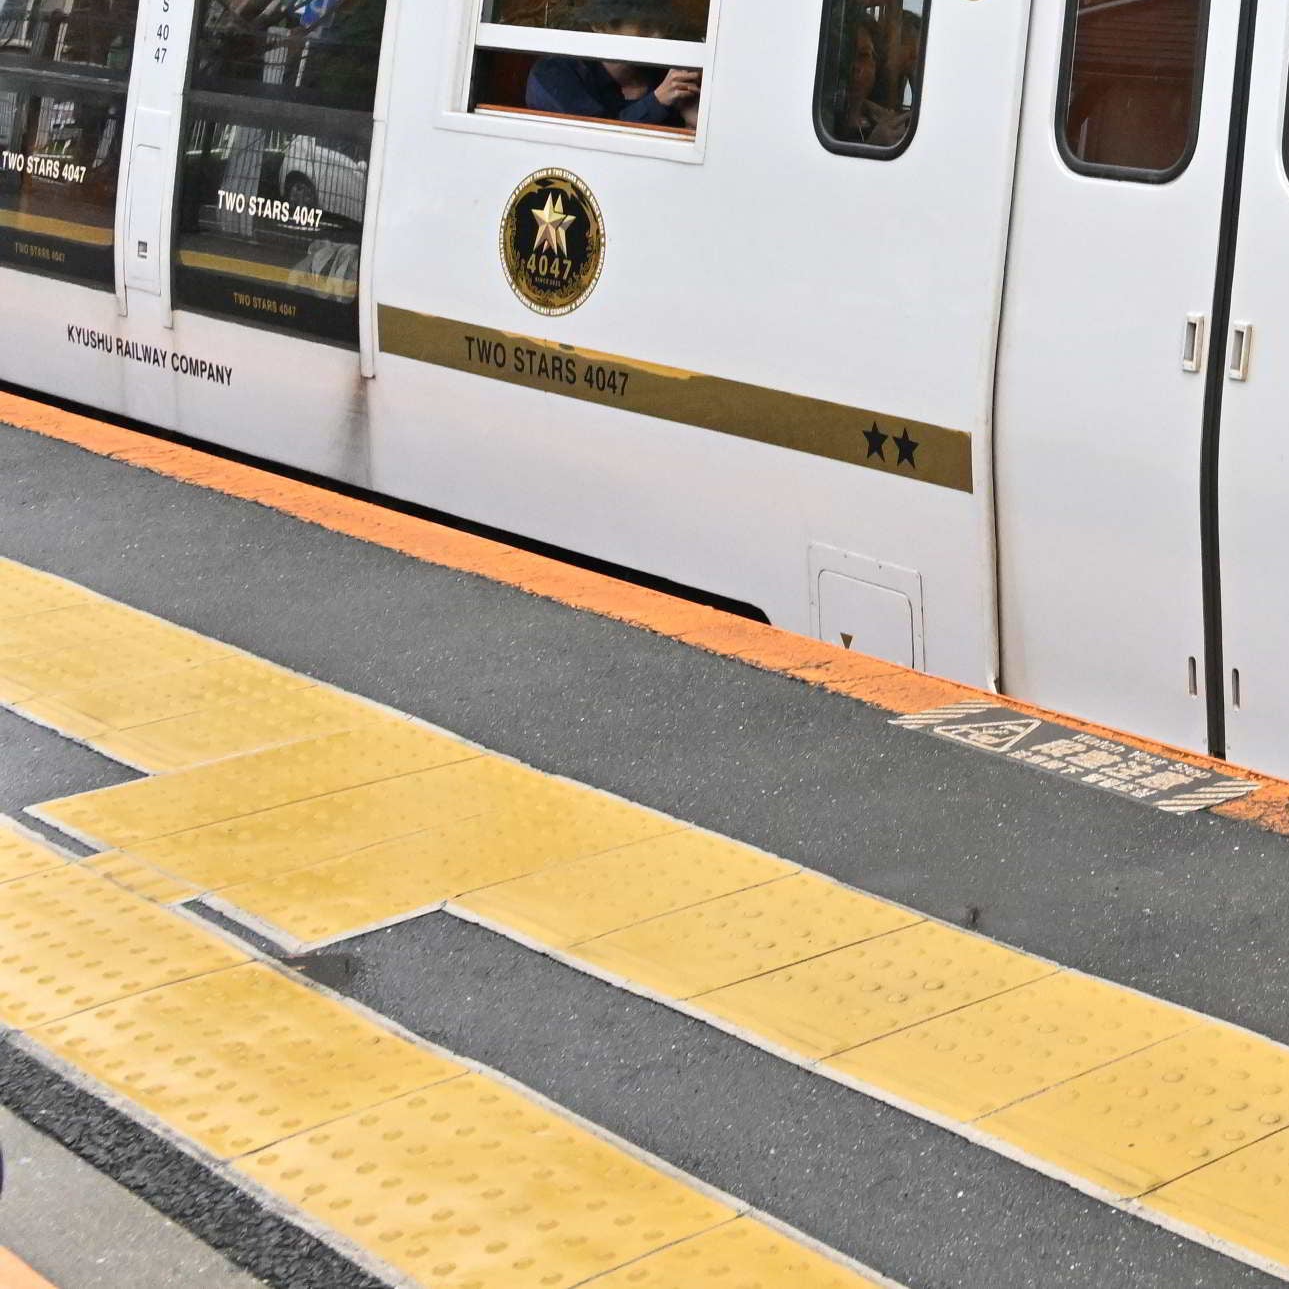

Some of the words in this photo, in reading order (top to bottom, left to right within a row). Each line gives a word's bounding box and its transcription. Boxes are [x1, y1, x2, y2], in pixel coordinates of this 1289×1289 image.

[1, 150, 25, 172] TWO
[26, 156, 61, 180] STARS
[61, 164, 87, 184] 4047
[217, 190, 245, 213] TWO
[247, 196, 290, 222] STARS
[292, 206, 323, 228] 4047
[526, 253, 572, 280] 4047
[233, 292, 251, 307] TWO
[252, 297, 278, 313] STARS
[278, 301, 297, 317] 4047
[67, 323, 114, 354] KYUSHU
[116, 337, 169, 369] RAILWAY
[171, 353, 233, 387] COMPANY
[464, 336, 506, 368] TWO
[514, 346, 577, 384] STARS
[584, 364, 629, 396] 4047
